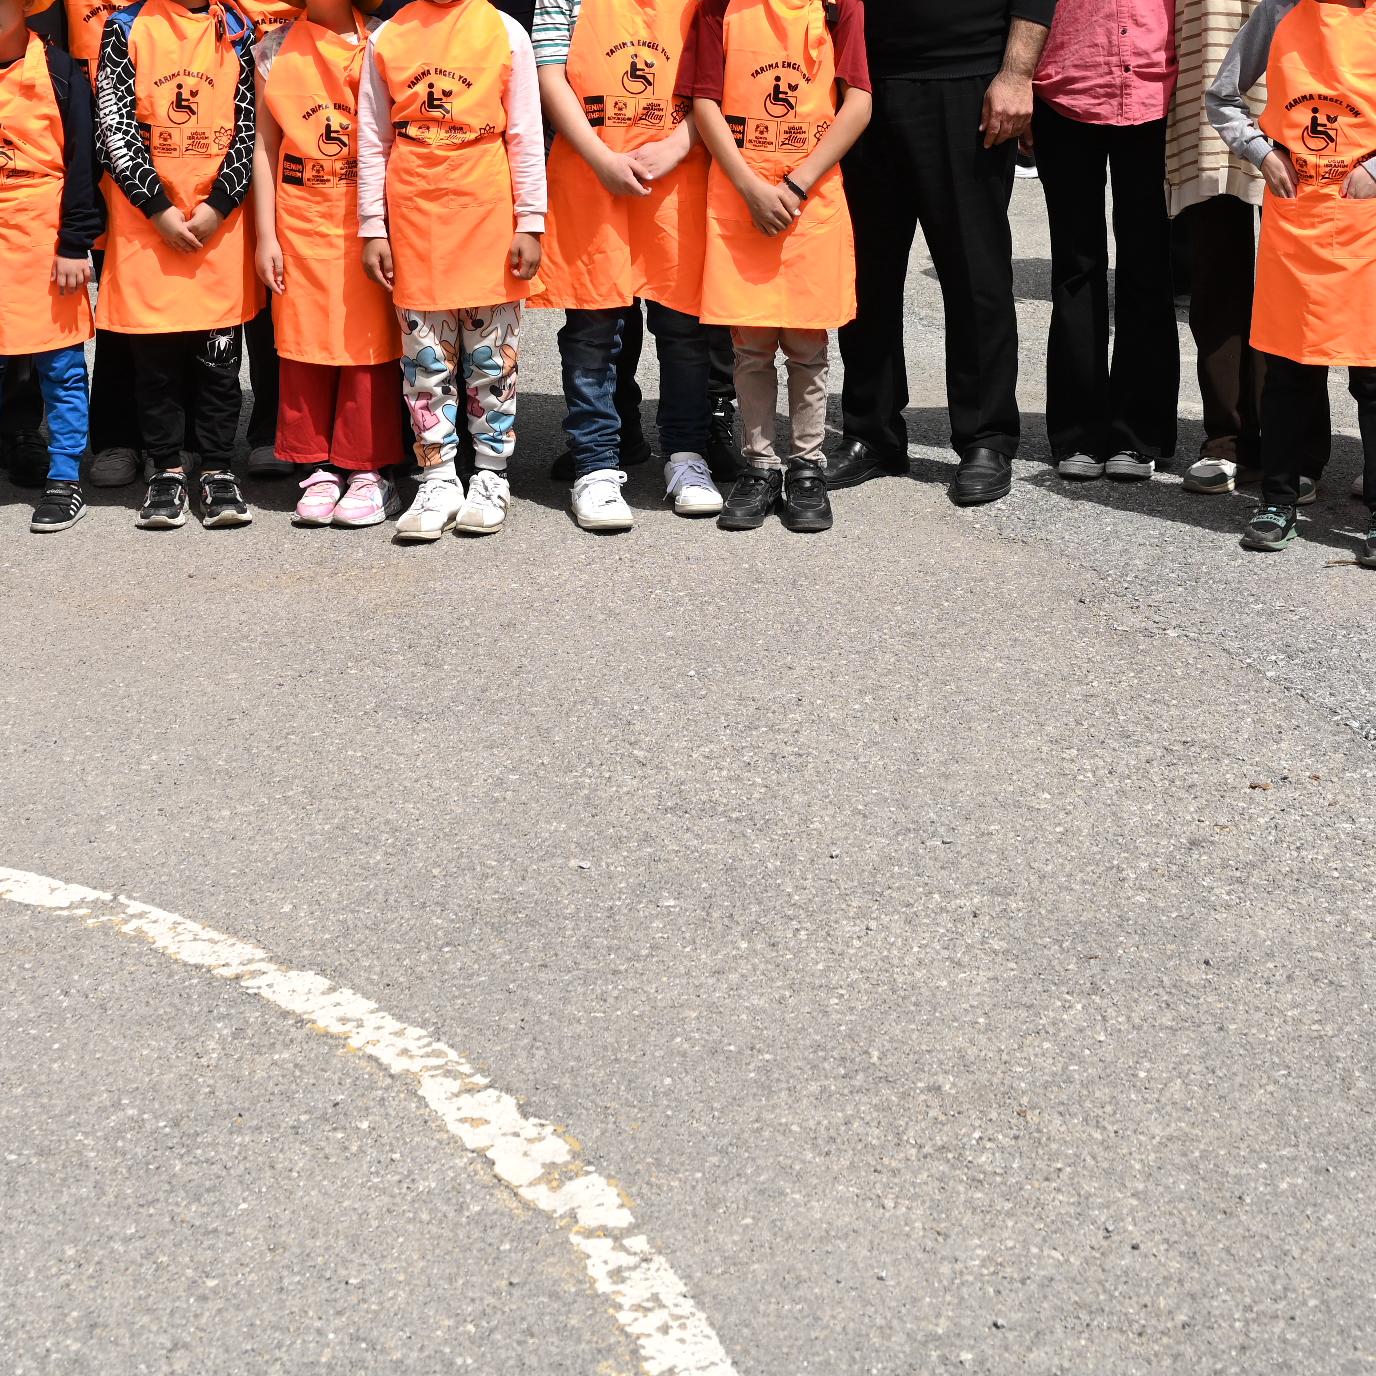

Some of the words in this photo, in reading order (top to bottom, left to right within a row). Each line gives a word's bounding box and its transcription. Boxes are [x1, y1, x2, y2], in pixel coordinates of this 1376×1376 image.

[606, 41, 635, 58] TARIMA
[638, 39, 659, 52] ENGEL
[153, 70, 181, 88] TARIMA
[407, 69, 432, 91] TARIMA
[435, 67, 456, 80] ENGEL
[458, 74, 473, 89] YOK
[751, 62, 780, 80] TARIMA
[1285, 94, 1315, 112] TARIMA
[1318, 94, 1344, 106] ENGEL
[1345, 104, 1362, 118] YOK
